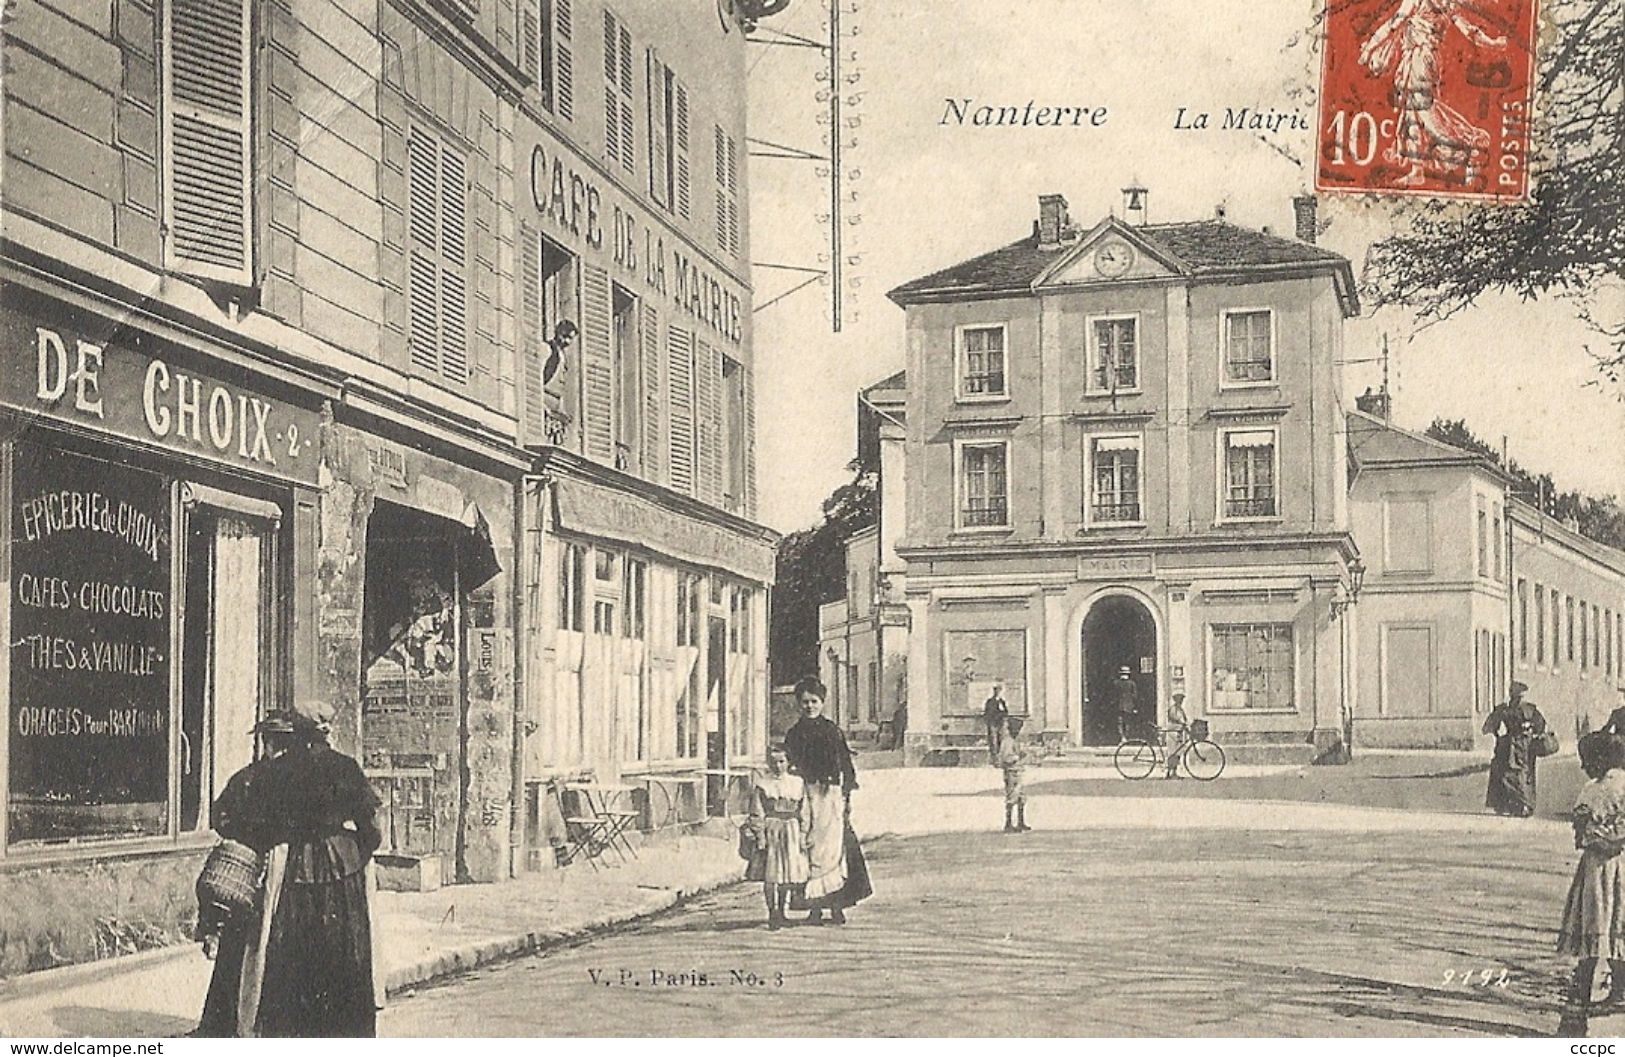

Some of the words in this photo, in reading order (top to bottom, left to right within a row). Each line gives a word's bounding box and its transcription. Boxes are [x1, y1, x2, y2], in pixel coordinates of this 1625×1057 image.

[1499, 100, 1524, 187] POSTES
[613, 204, 636, 270] DE
[645, 226, 666, 296] LA
[674, 250, 742, 344] MAIRIE
[37, 327, 104, 419] DE
[143, 359, 276, 466] CHOIX
[22, 490, 101, 541] EPICERIE
[101, 498, 116, 534] de
[118, 501, 161, 561] CHOIX
[19, 573, 70, 609] CAFES
[80, 581, 164, 619] CHOCOLATS
[27, 634, 76, 670] THES
[79, 646, 92, 671] &
[92, 640, 156, 676] VANILLE
